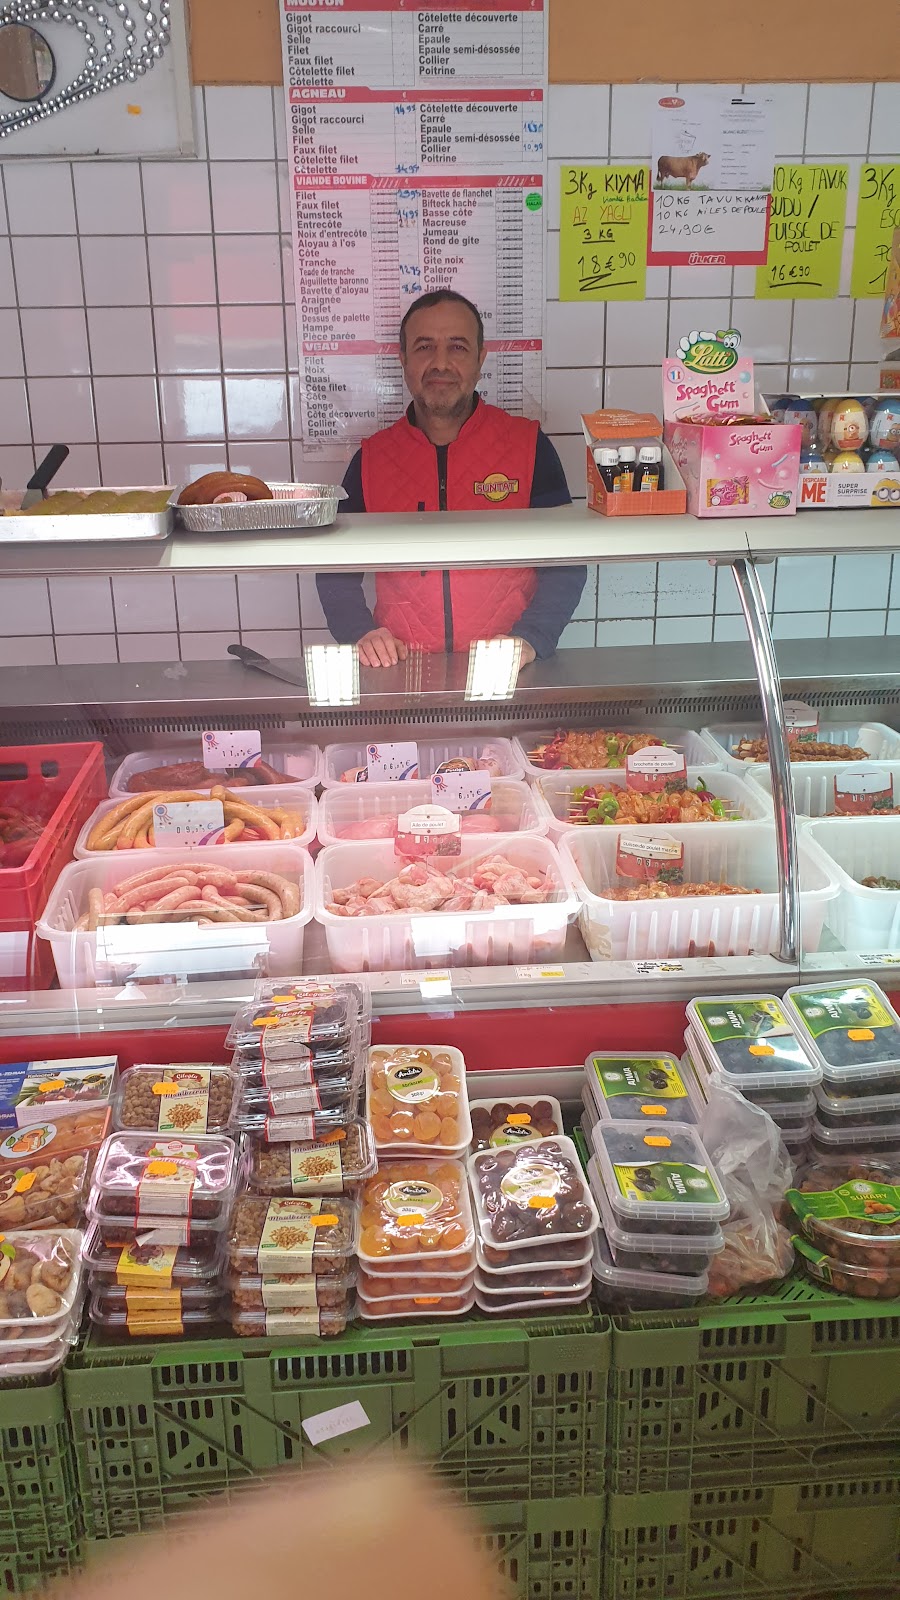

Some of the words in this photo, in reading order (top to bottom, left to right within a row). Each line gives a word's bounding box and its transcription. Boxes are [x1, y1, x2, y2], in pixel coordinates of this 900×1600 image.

[286, 13, 312, 24] Gigot
[418, 13, 462, 22] Côtelette
[465, 13, 518, 22] découverte
[287, 24, 312, 35] Gigot
[316, 24, 361, 33] raccourci
[418, 24, 444, 33] Carré
[287, 35, 311, 44] Selle
[419, 34, 450, 45] Epaule
[288, 46, 309, 55] Filet
[419, 45, 450, 56] Epaule
[454, 45, 520, 54] semi-désossée
[289, 56, 311, 65] Faux
[314, 56, 333, 65] filet
[419, 56, 449, 65] Collier
[289, 66, 333, 76] Côtelette
[336, 66, 355, 76] filet
[420, 66, 455, 75] Poitrine
[290, 77, 334, 86] Côtelette
[292, 89, 346, 98] AGNEAU
[291, 105, 316, 116] Gigot
[420, 104, 463, 113] Côtelette
[466, 104, 518, 112] découverte
[292, 115, 316, 126] Gigot
[320, 115, 364, 124] raccourci
[420, 114, 446, 123] Carré
[292, 126, 315, 134] Selle
[421, 124, 452, 134] Epaule
[293, 136, 314, 144] Filet
[421, 134, 452, 144] Epaule
[454, 133, 520, 142] semi-désossée
[294, 146, 316, 154] Faux
[319, 145, 337, 154] filet
[421, 144, 451, 153] Collier
[294, 156, 337, 164] Côtelette
[340, 156, 358, 164] filet
[421, 154, 456, 163] Poitrine
[295, 166, 337, 174] Côtelette
[296, 176, 331, 185] VIANDE
[333, 176, 367, 185] BOVINE
[565, 170, 597, 200] 3Kg
[605, 169, 644, 193] KIYMA
[789, 169, 802, 194] Kg
[861, 168, 897, 208] 3Kg
[296, 192, 316, 200] Filet
[422, 190, 450, 198] Bavette
[452, 190, 460, 198] de
[463, 189, 492, 198] flanchet
[297, 201, 318, 210] Faux
[321, 201, 339, 209] filet
[422, 199, 450, 208] Bifteck
[453, 199, 477, 207] haché
[656, 195, 674, 209] 10
[297, 211, 343, 219] Rumsteck
[423, 209, 449, 217] Basse
[452, 208, 473, 217] côte
[573, 206, 588, 222] AZ
[656, 211, 670, 220] 10
[732, 206, 741, 214] DE
[298, 220, 342, 229] Entrecôte
[298, 230, 317, 238] Noix
[320, 230, 367, 238] d'entrecôte
[423, 228, 458, 236] Jumeau
[584, 228, 592, 240] 3
[599, 228, 613, 239] KG
[820, 221, 840, 240] DE
[298, 240, 329, 249] Aloyau
[340, 239, 356, 247] l'os
[423, 237, 446, 245] Rond
[449, 237, 460, 245] de
[784, 241, 820, 253] POULET
[299, 249, 320, 257] Côte
[299, 259, 336, 267] Tranche
[445, 256, 464, 264] noix
[689, 252, 726, 265] ÜLKER
[321, 268, 329, 276] de
[331, 268, 354, 276] tranche
[424, 266, 458, 274] Paleron
[300, 277, 337, 287] Aiguillette
[340, 277, 369, 285] baronne
[424, 275, 453, 283] Collier
[301, 287, 332, 295] Bavette
[335, 286, 369, 295] d'aloyau
[424, 284, 451, 293] Jarret
[301, 296, 341, 305] Araignée
[302, 305, 331, 314] Onglet
[302, 314, 329, 322] Dessus
[332, 314, 341, 322] de
[343, 314, 370, 323] palette
[303, 324, 334, 332] Hampe
[331, 333, 356, 341] parée
[305, 342, 339, 351] VEAU
[305, 357, 324, 365] Filet
[684, 344, 731, 370] Lutti
[305, 375, 330, 383] Quasi
[306, 384, 326, 392] Côte
[329, 384, 346, 392] filet
[307, 402, 334, 411] Longe
[706, 395, 739, 412] Gum
[329, 410, 375, 418] découverte
[309, 428, 338, 438] Epaule
[750, 442, 773, 454] Gum
[476, 482, 515, 493] SUNTAT
[801, 483, 827, 503] ME
